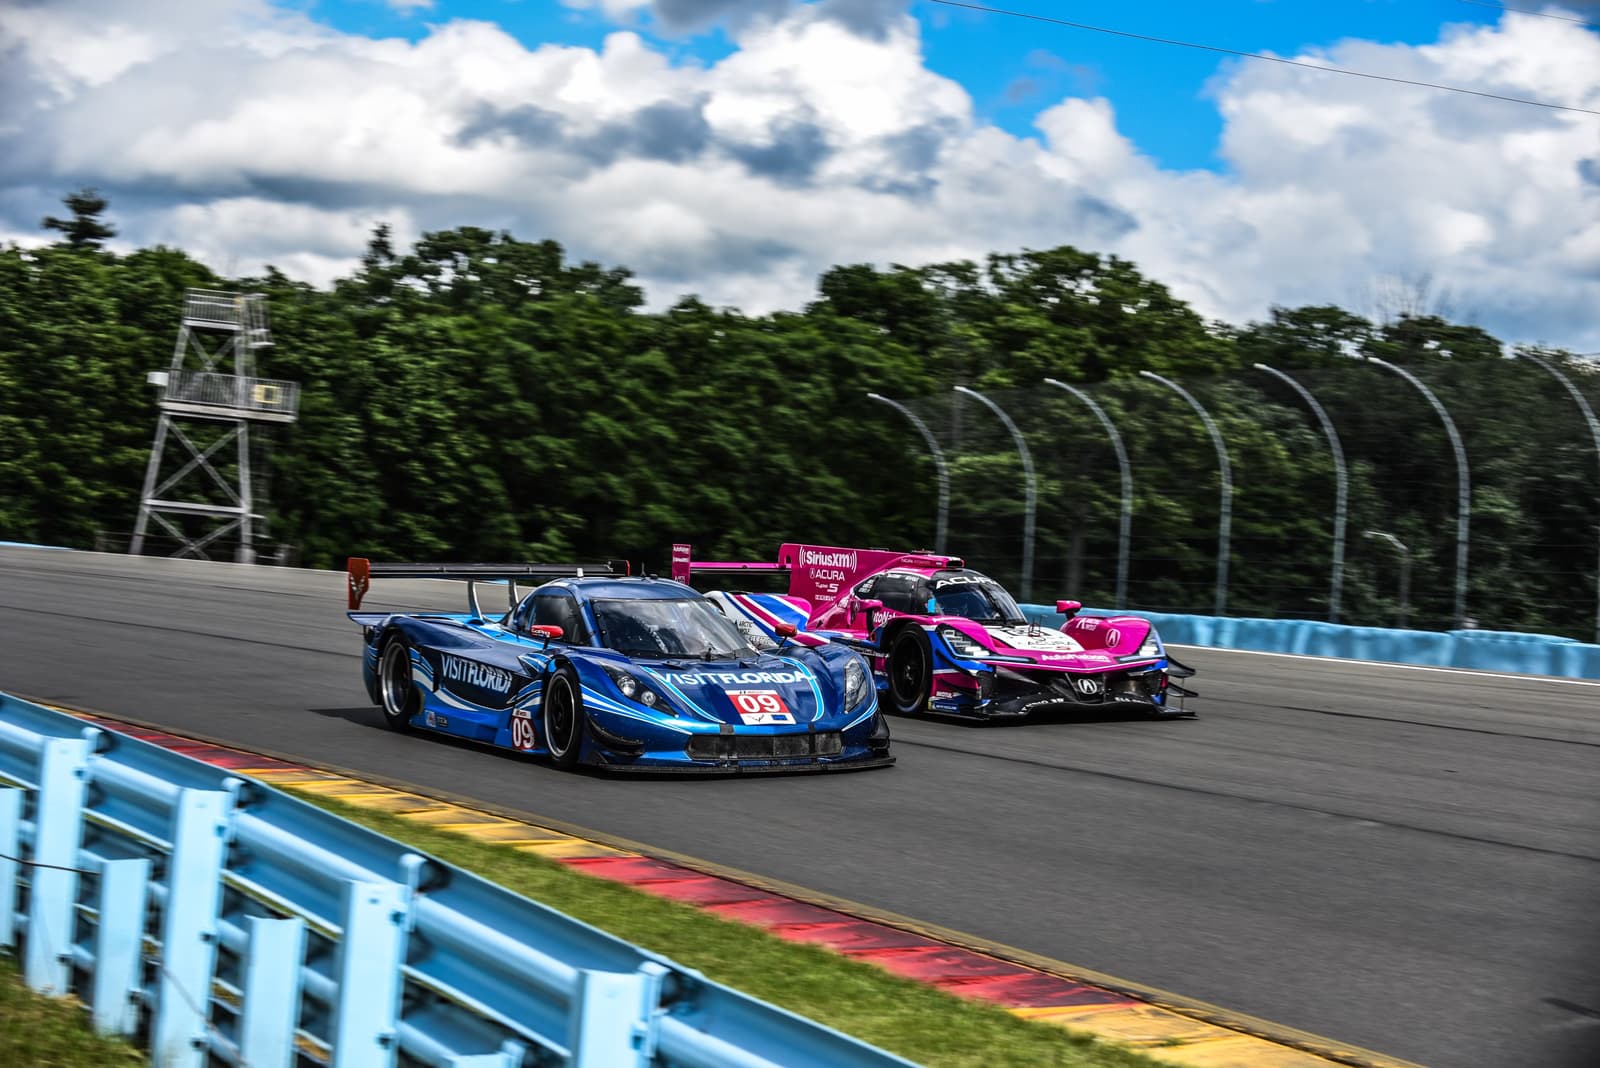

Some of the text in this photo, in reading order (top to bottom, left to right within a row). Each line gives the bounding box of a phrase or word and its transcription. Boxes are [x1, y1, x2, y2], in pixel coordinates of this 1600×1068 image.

[806, 550, 850, 568] SiriusXM
[815, 569, 845, 581] ACURA
[827, 583, 839, 593] S
[736, 695, 781, 714] 09
[512, 718, 535, 748] 09
